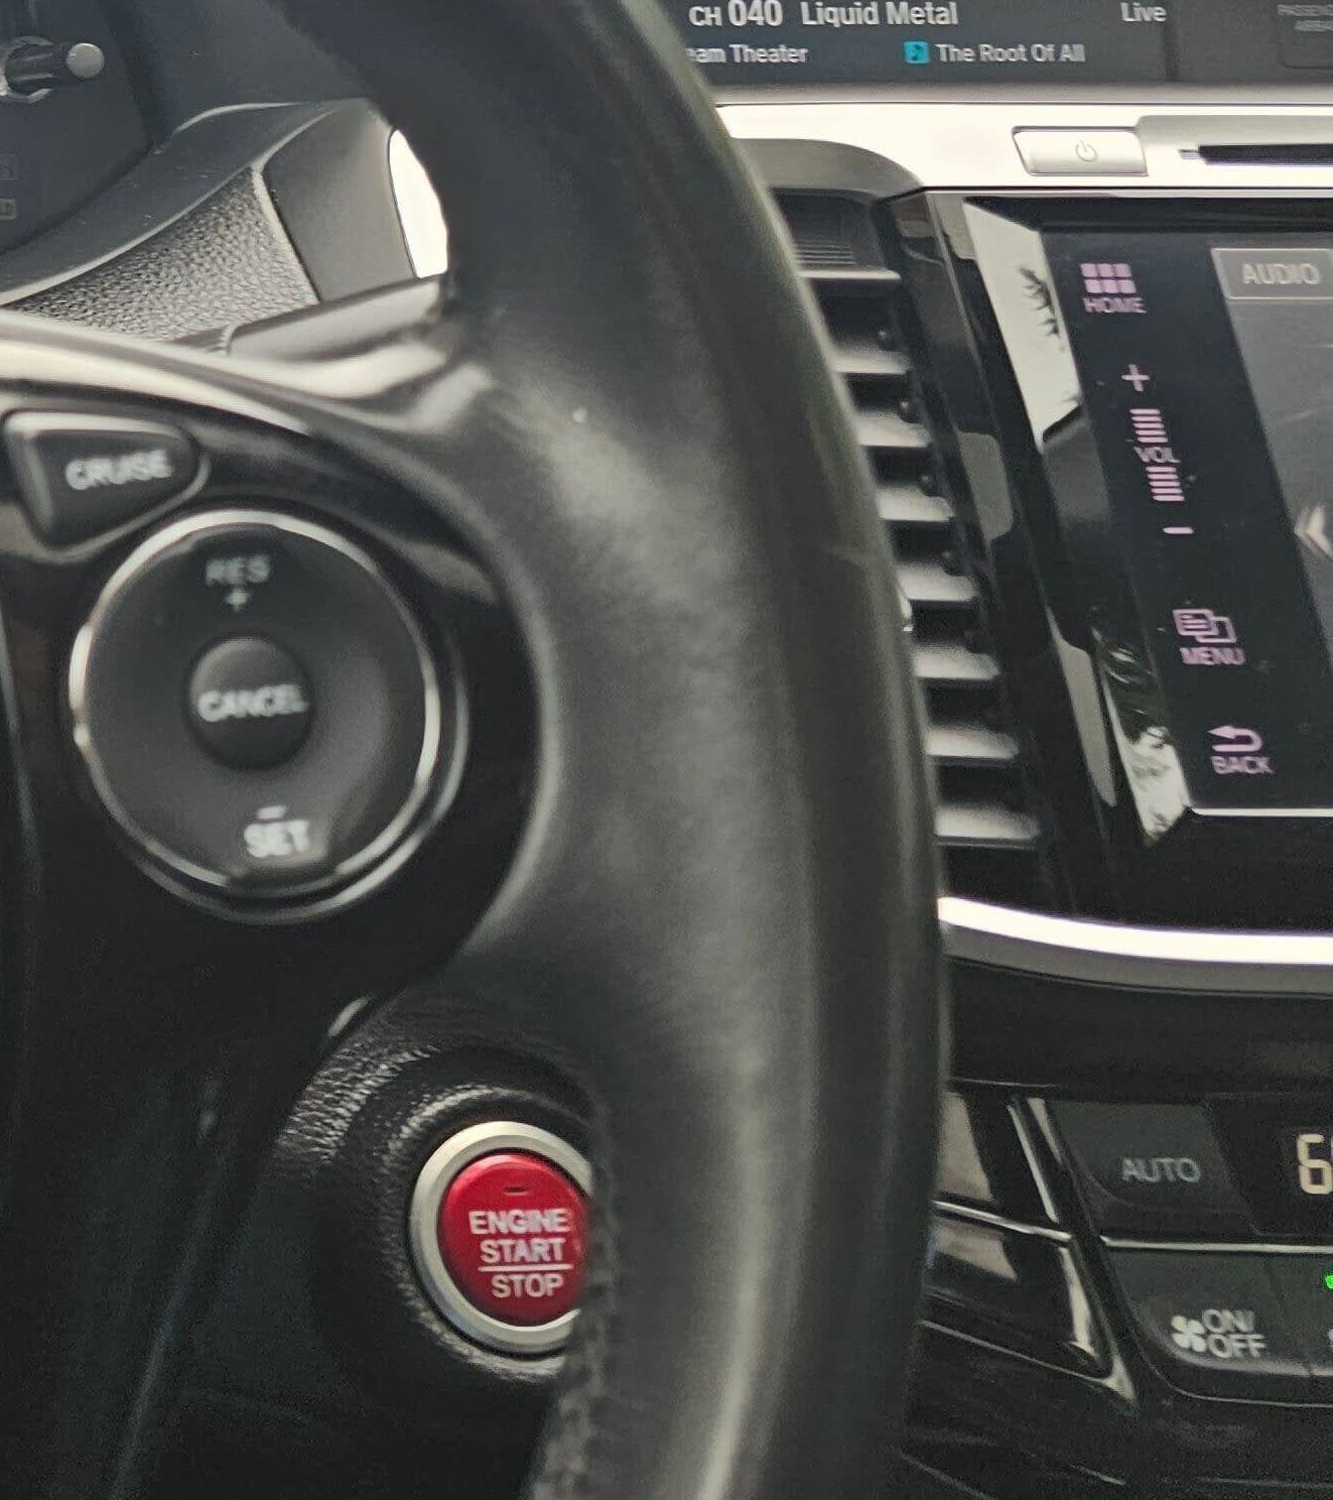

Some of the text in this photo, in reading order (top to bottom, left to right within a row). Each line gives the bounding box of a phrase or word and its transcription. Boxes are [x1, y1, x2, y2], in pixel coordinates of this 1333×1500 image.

[689, 0, 1167, 31] CH 040 Liquid Metal Live
[729, 44, 809, 63] Theater
[935, 44, 1085, 62] The Root Of All
[1242, 264, 1322, 285] AUDIO
[1083, 297, 1147, 314] HOME
[1133, 446, 1180, 464] VOL
[65, 448, 174, 490] CRUISE
[1180, 647, 1247, 666] MENU
[1210, 756, 1275, 775] BACK
[244, 819, 311, 858] SET
[1121, 1157, 1201, 1184] AUTO
[469, 1208, 571, 1235] ENGINE
[480, 1238, 566, 1264] START
[492, 1274, 564, 1299] STOP
[1207, 1334, 1268, 1358] OFF
